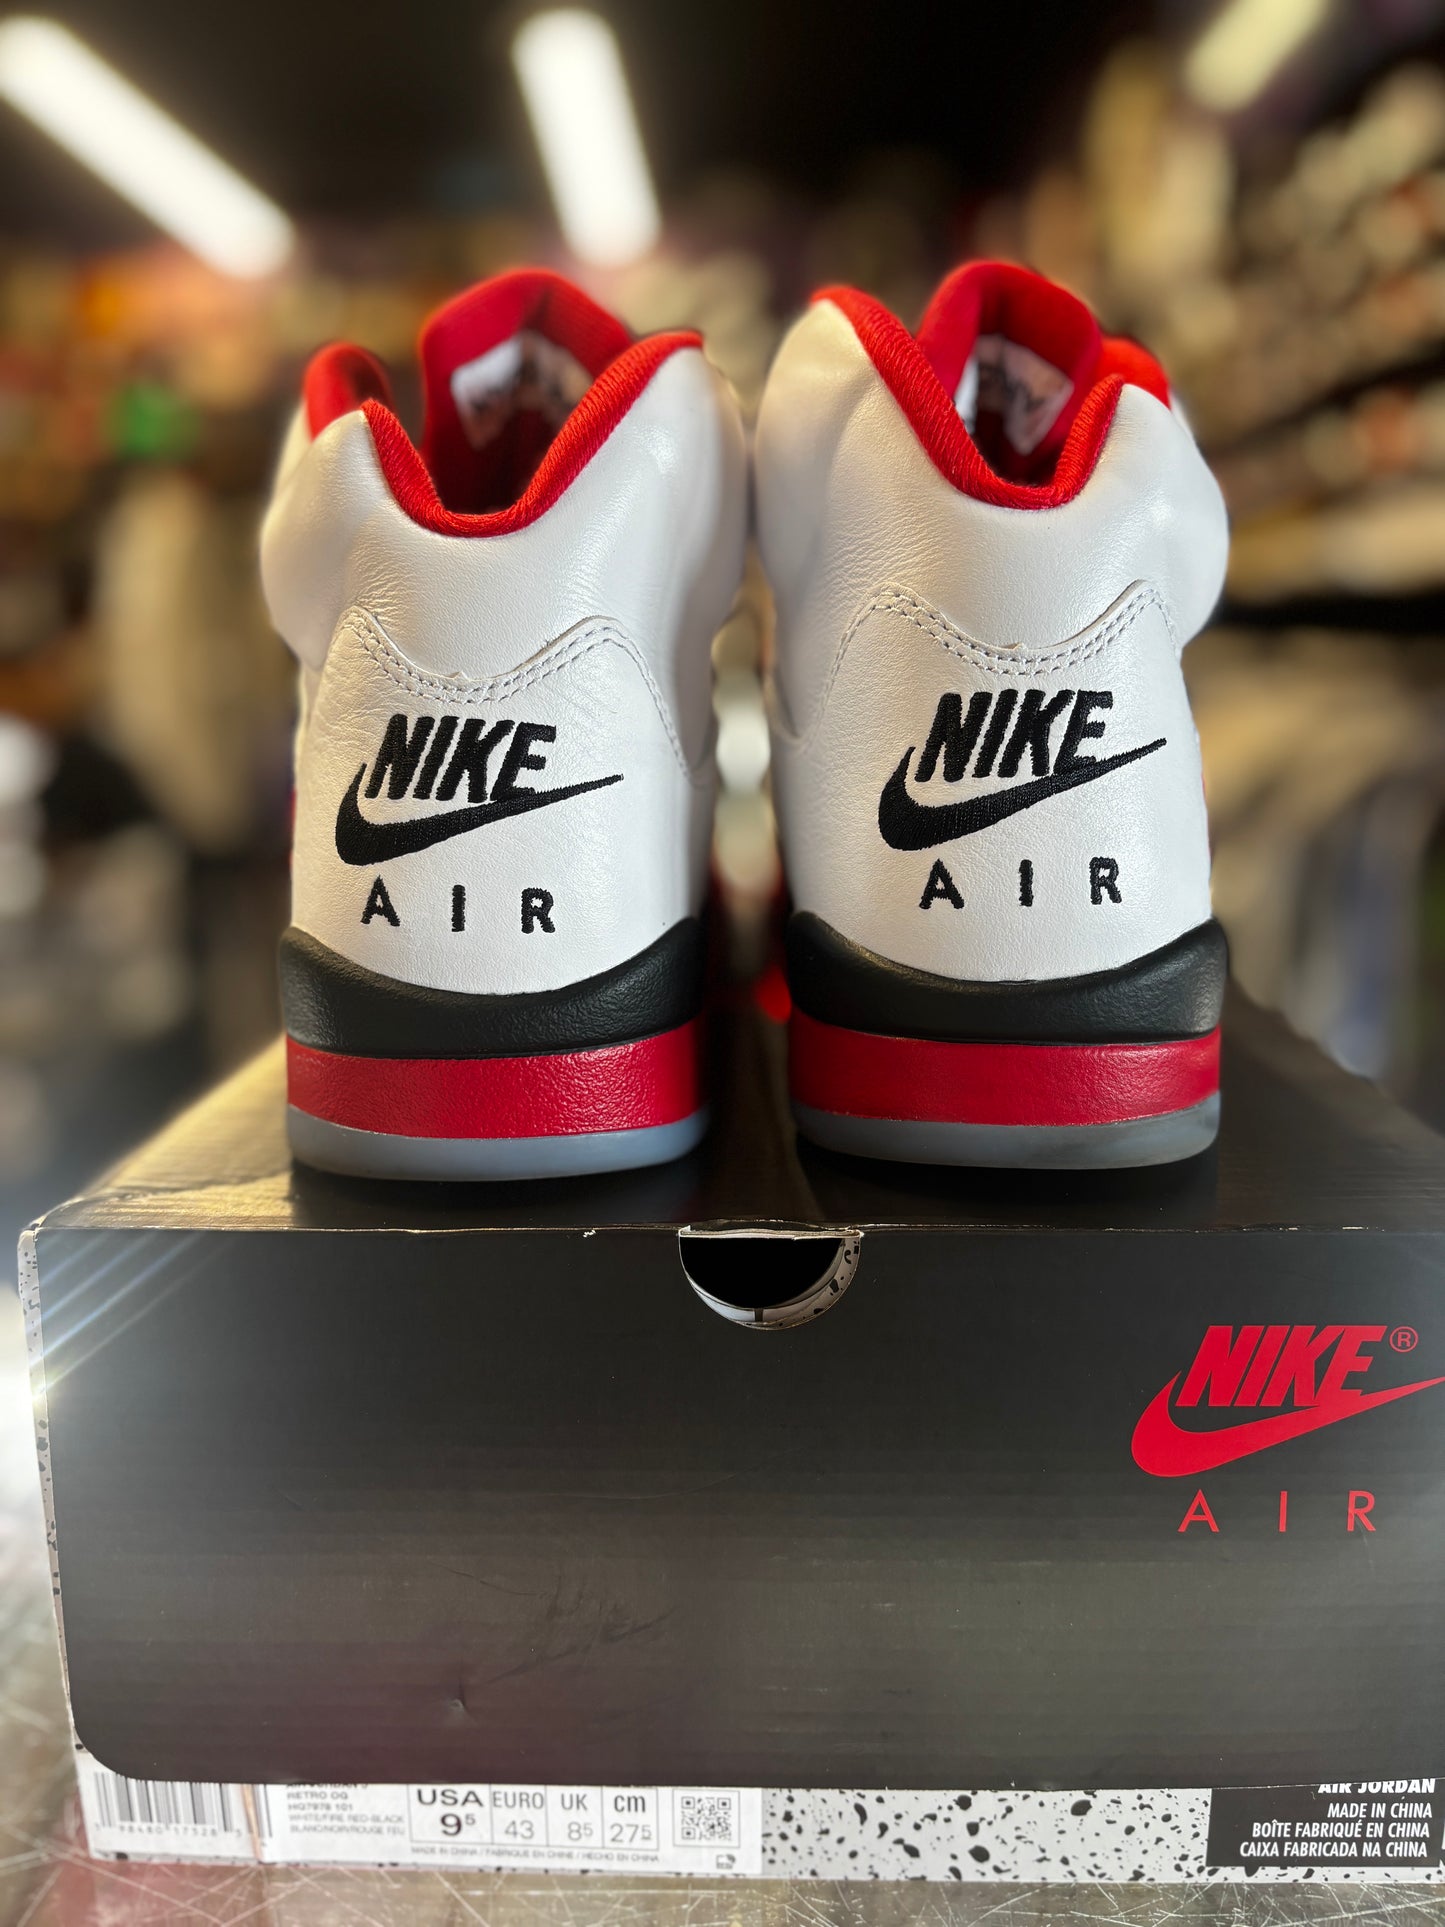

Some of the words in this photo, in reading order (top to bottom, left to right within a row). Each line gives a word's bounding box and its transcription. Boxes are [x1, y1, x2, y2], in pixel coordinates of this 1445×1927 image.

[914, 688, 1114, 782] NIKE
[364, 714, 557, 803] NIKE
[918, 856, 1123, 910] AIR
[360, 874, 556, 934] AIR
[1175, 1325, 1387, 1407] NIKE
[1177, 1489, 1377, 1533] AIR
[286, 1791, 328, 1800] RETRO
[1318, 1783, 1352, 1794] AIR
[1358, 1779, 1436, 1794] JORDAN
[417, 1788, 484, 1807] USA
[492, 1790, 545, 1810] EURO
[560, 1792, 588, 1811] UK
[613, 1794, 646, 1813] cm
[1327, 1803, 1368, 1818] MADE
[1371, 1803, 1386, 1818] IN
[1390, 1803, 1433, 1818] CHINA
[504, 1820, 535, 1839] 43
[1252, 1819, 1291, 1838] BOÎTE
[1295, 1819, 1362, 1838] FABRIQUÉ
[1366, 1823, 1384, 1838] EN
[1388, 1823, 1430, 1838] CHINA
[1240, 1842, 1279, 1857] CAIXA
[1283, 1842, 1358, 1857] FABRICADA
[1362, 1842, 1381, 1857] NA
[1385, 1842, 1428, 1857] CHINA
